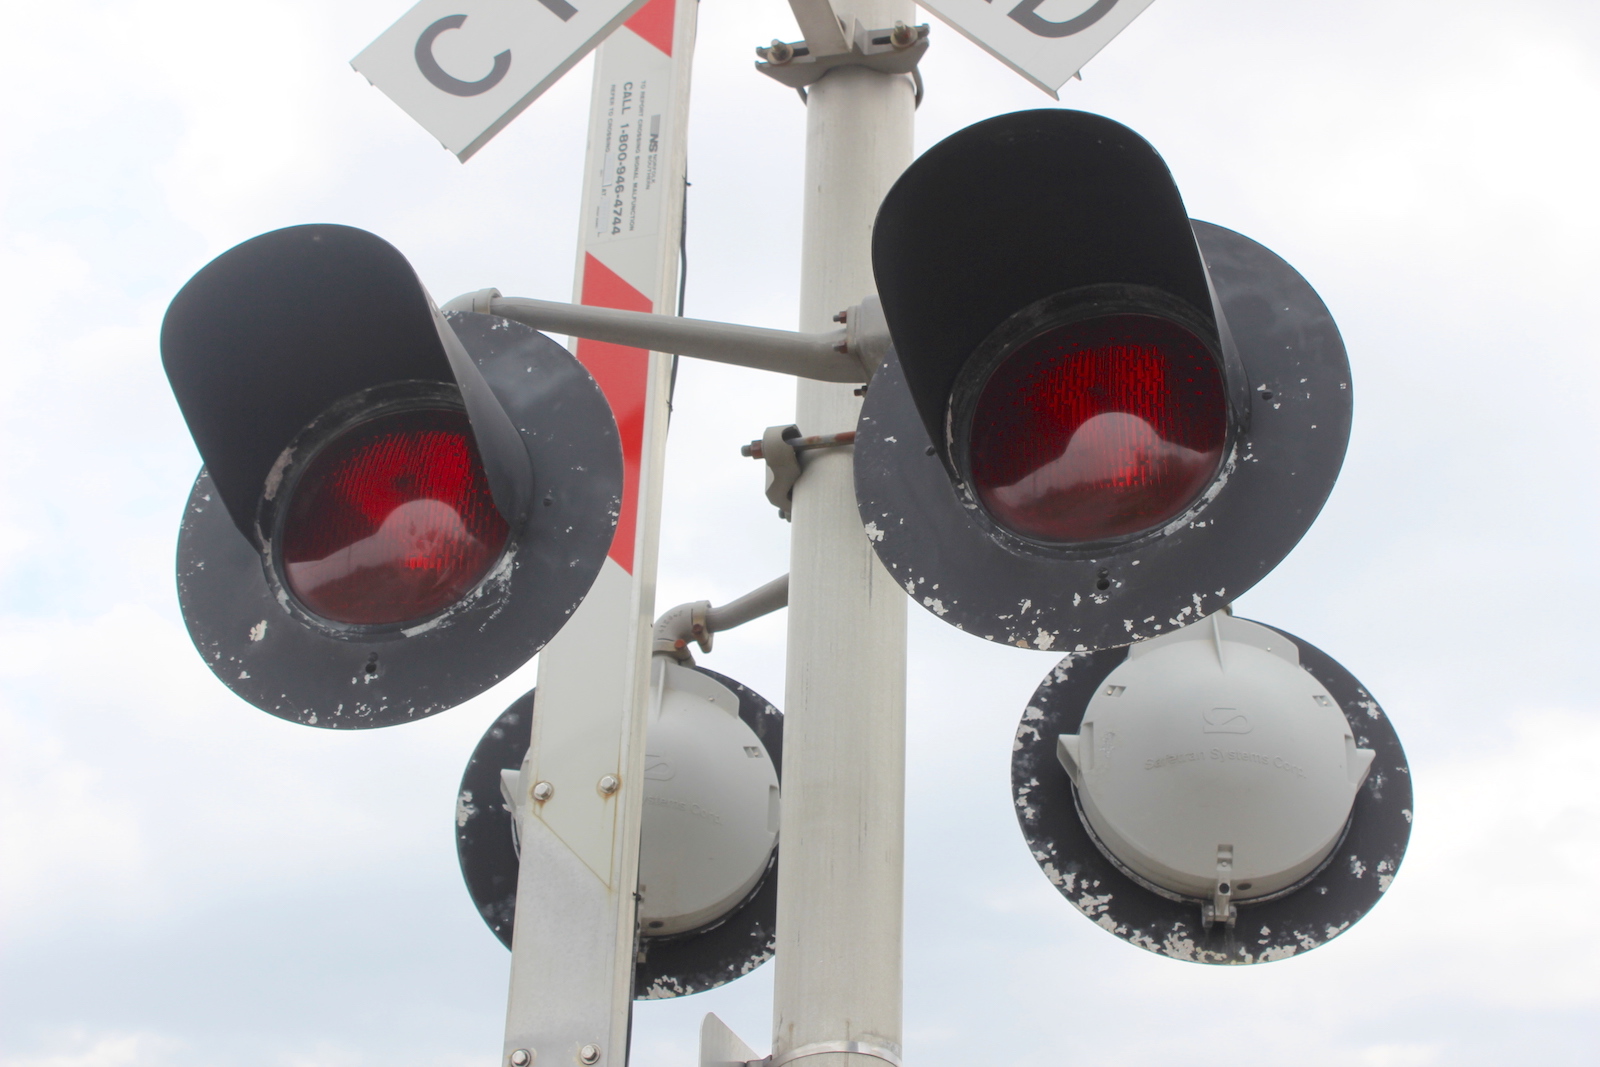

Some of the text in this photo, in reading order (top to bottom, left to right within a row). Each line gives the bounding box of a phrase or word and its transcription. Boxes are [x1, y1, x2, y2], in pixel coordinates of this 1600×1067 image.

[640, 80, 646, 89] TO
[608, 107, 614, 116] TO
[635, 119, 643, 153] CROSSING
[648, 133, 659, 153] NS
[611, 82, 633, 235] CALL 1-800-946-4744
[629, 182, 638, 231] MALFUNCTION
[1209, 747, 1269, 767] Systems
